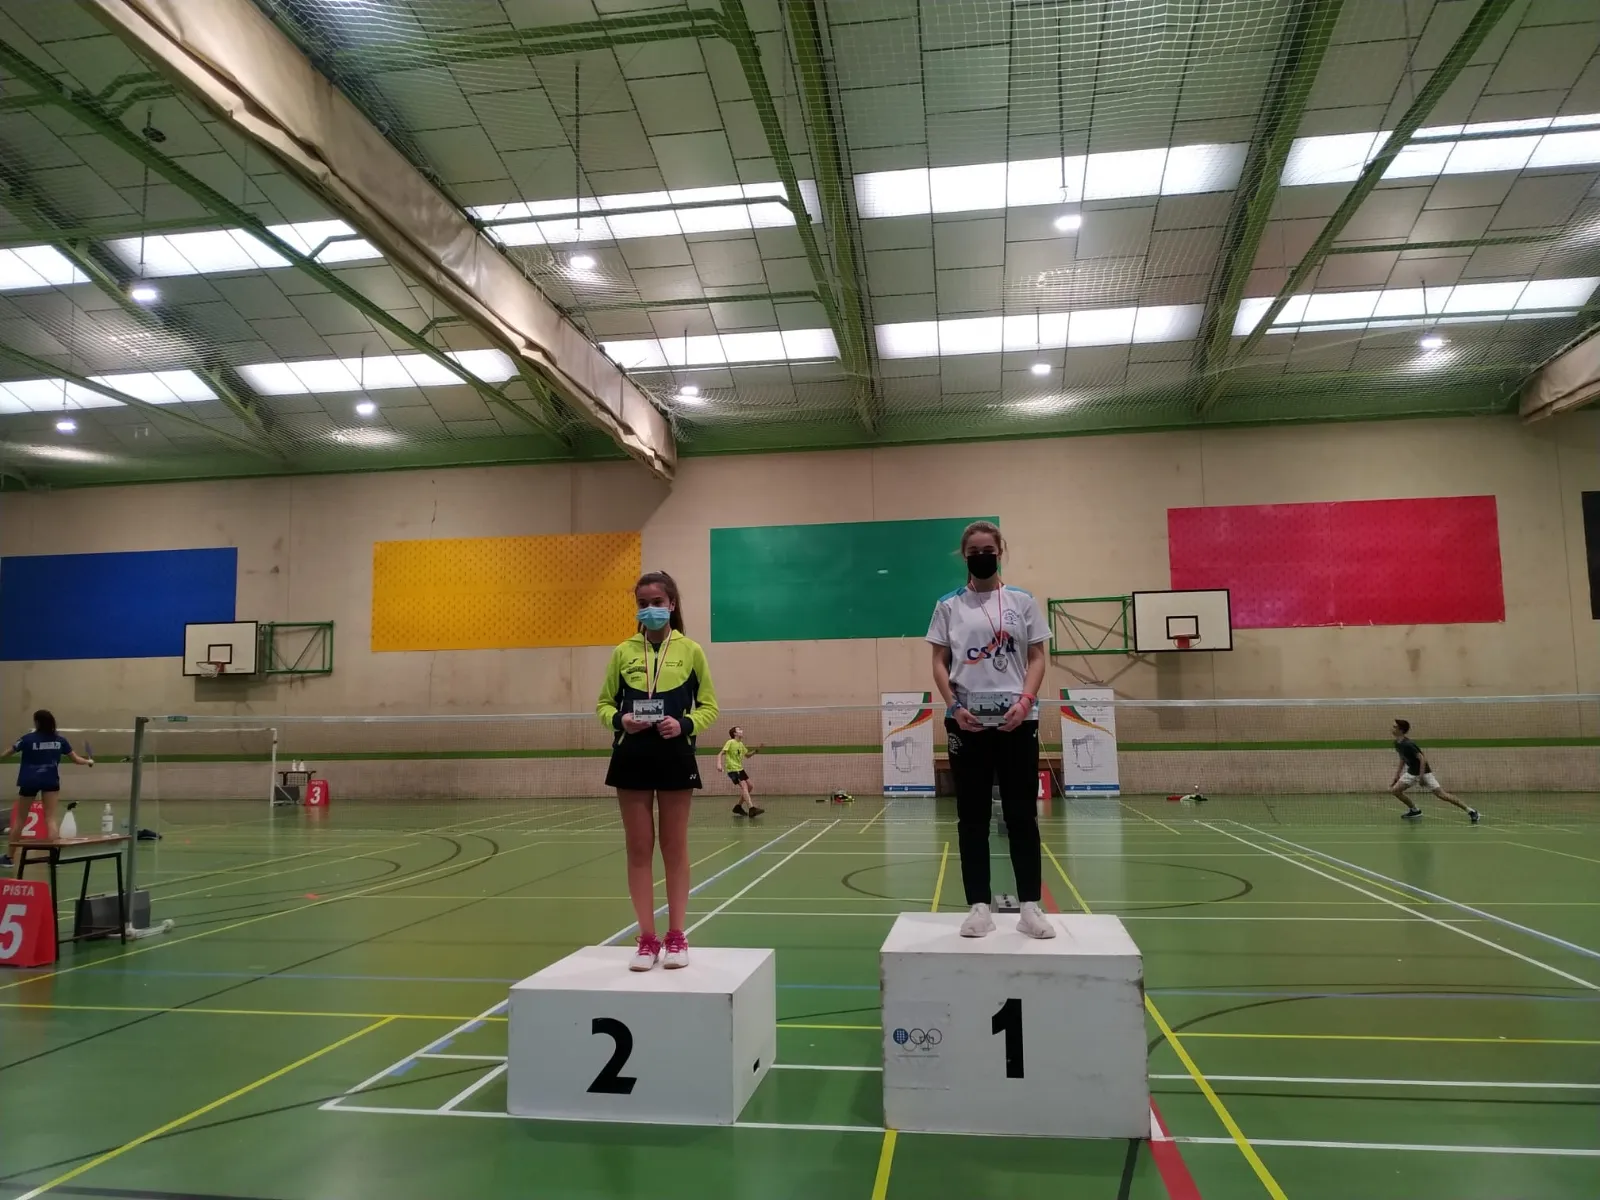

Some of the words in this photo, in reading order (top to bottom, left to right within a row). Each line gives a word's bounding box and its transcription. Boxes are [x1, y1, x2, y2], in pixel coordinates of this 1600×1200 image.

[310, 786, 321, 804] 3
[21, 812, 38, 836] 2
[2, 884, 34, 896] PISTA
[0, 904, 27, 959] 5
[586, 1017, 637, 1094] 2
[991, 998, 1024, 1079] 1
